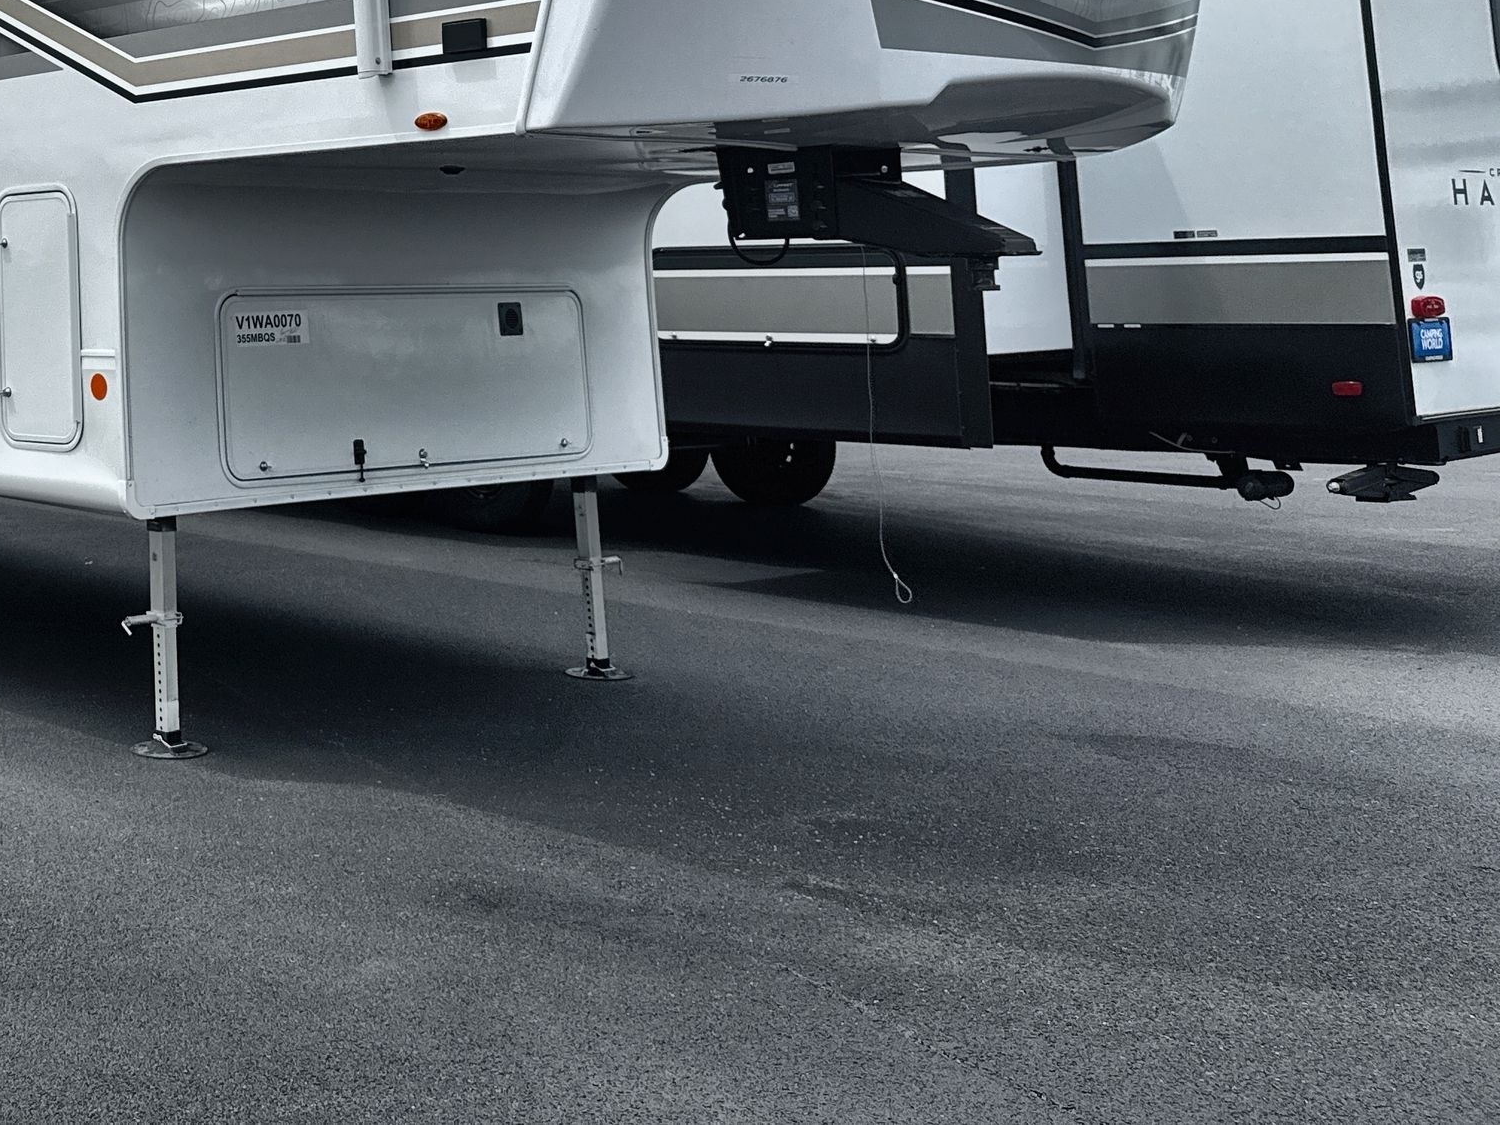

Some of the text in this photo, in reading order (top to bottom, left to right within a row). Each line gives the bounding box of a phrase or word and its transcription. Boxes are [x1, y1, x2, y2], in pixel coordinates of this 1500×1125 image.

[236, 313, 302, 330] V1WA0070
[237, 332, 276, 344] 355MBQS
[1420, 328, 1443, 339] CAMPING
[1421, 338, 1443, 350] WORLD
